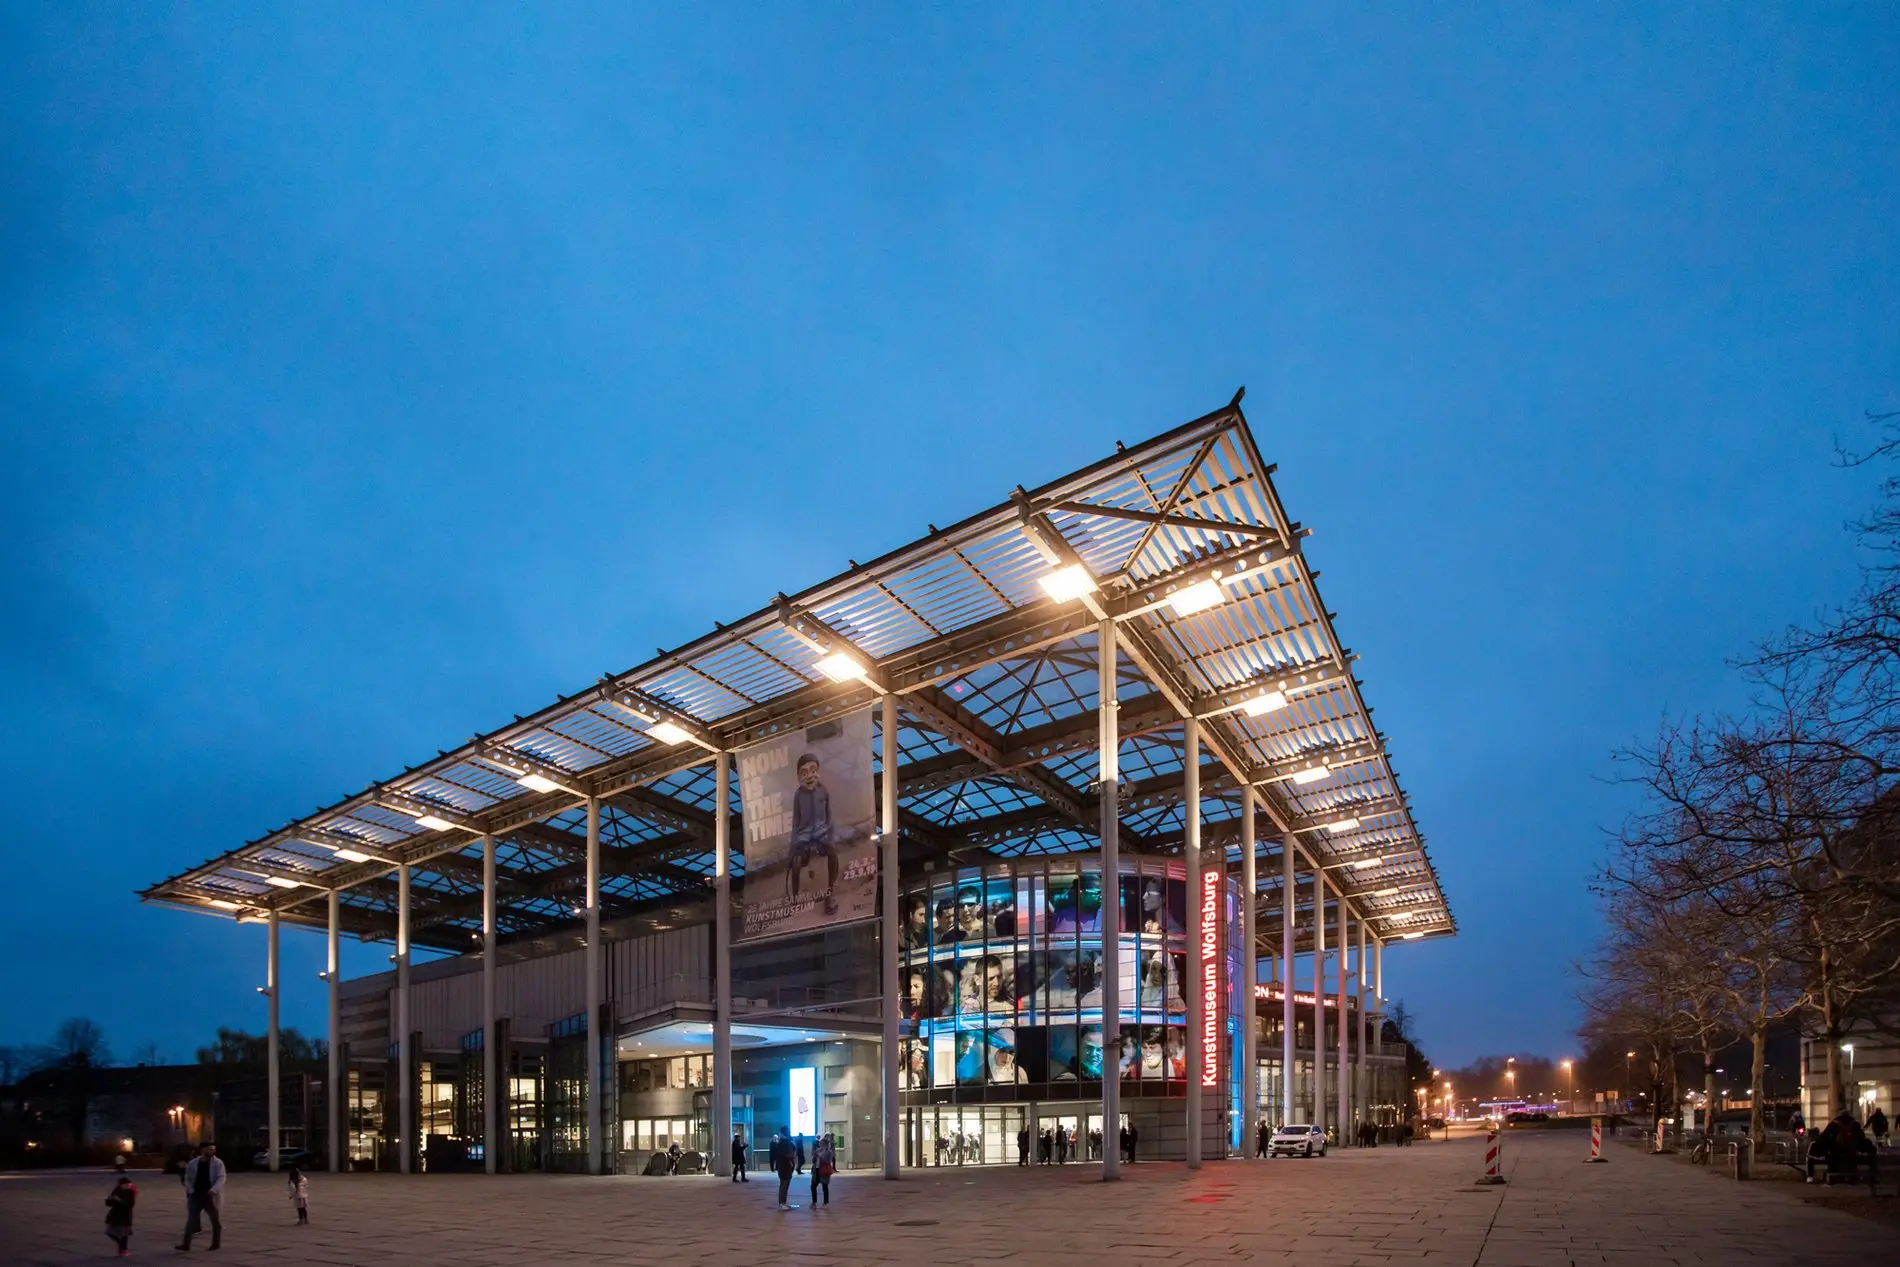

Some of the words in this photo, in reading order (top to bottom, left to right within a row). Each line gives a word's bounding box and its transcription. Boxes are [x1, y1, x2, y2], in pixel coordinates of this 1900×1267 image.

[741, 746, 789, 779] NOW
[744, 776, 764, 801] IS
[747, 791, 782, 821] THE
[749, 811, 793, 842] TIME
[746, 900, 815, 924] KUNSTMUSEUM
[1202, 871, 1219, 960] Wolfsburg
[1202, 963, 1217, 1086] Kunstmuseum
